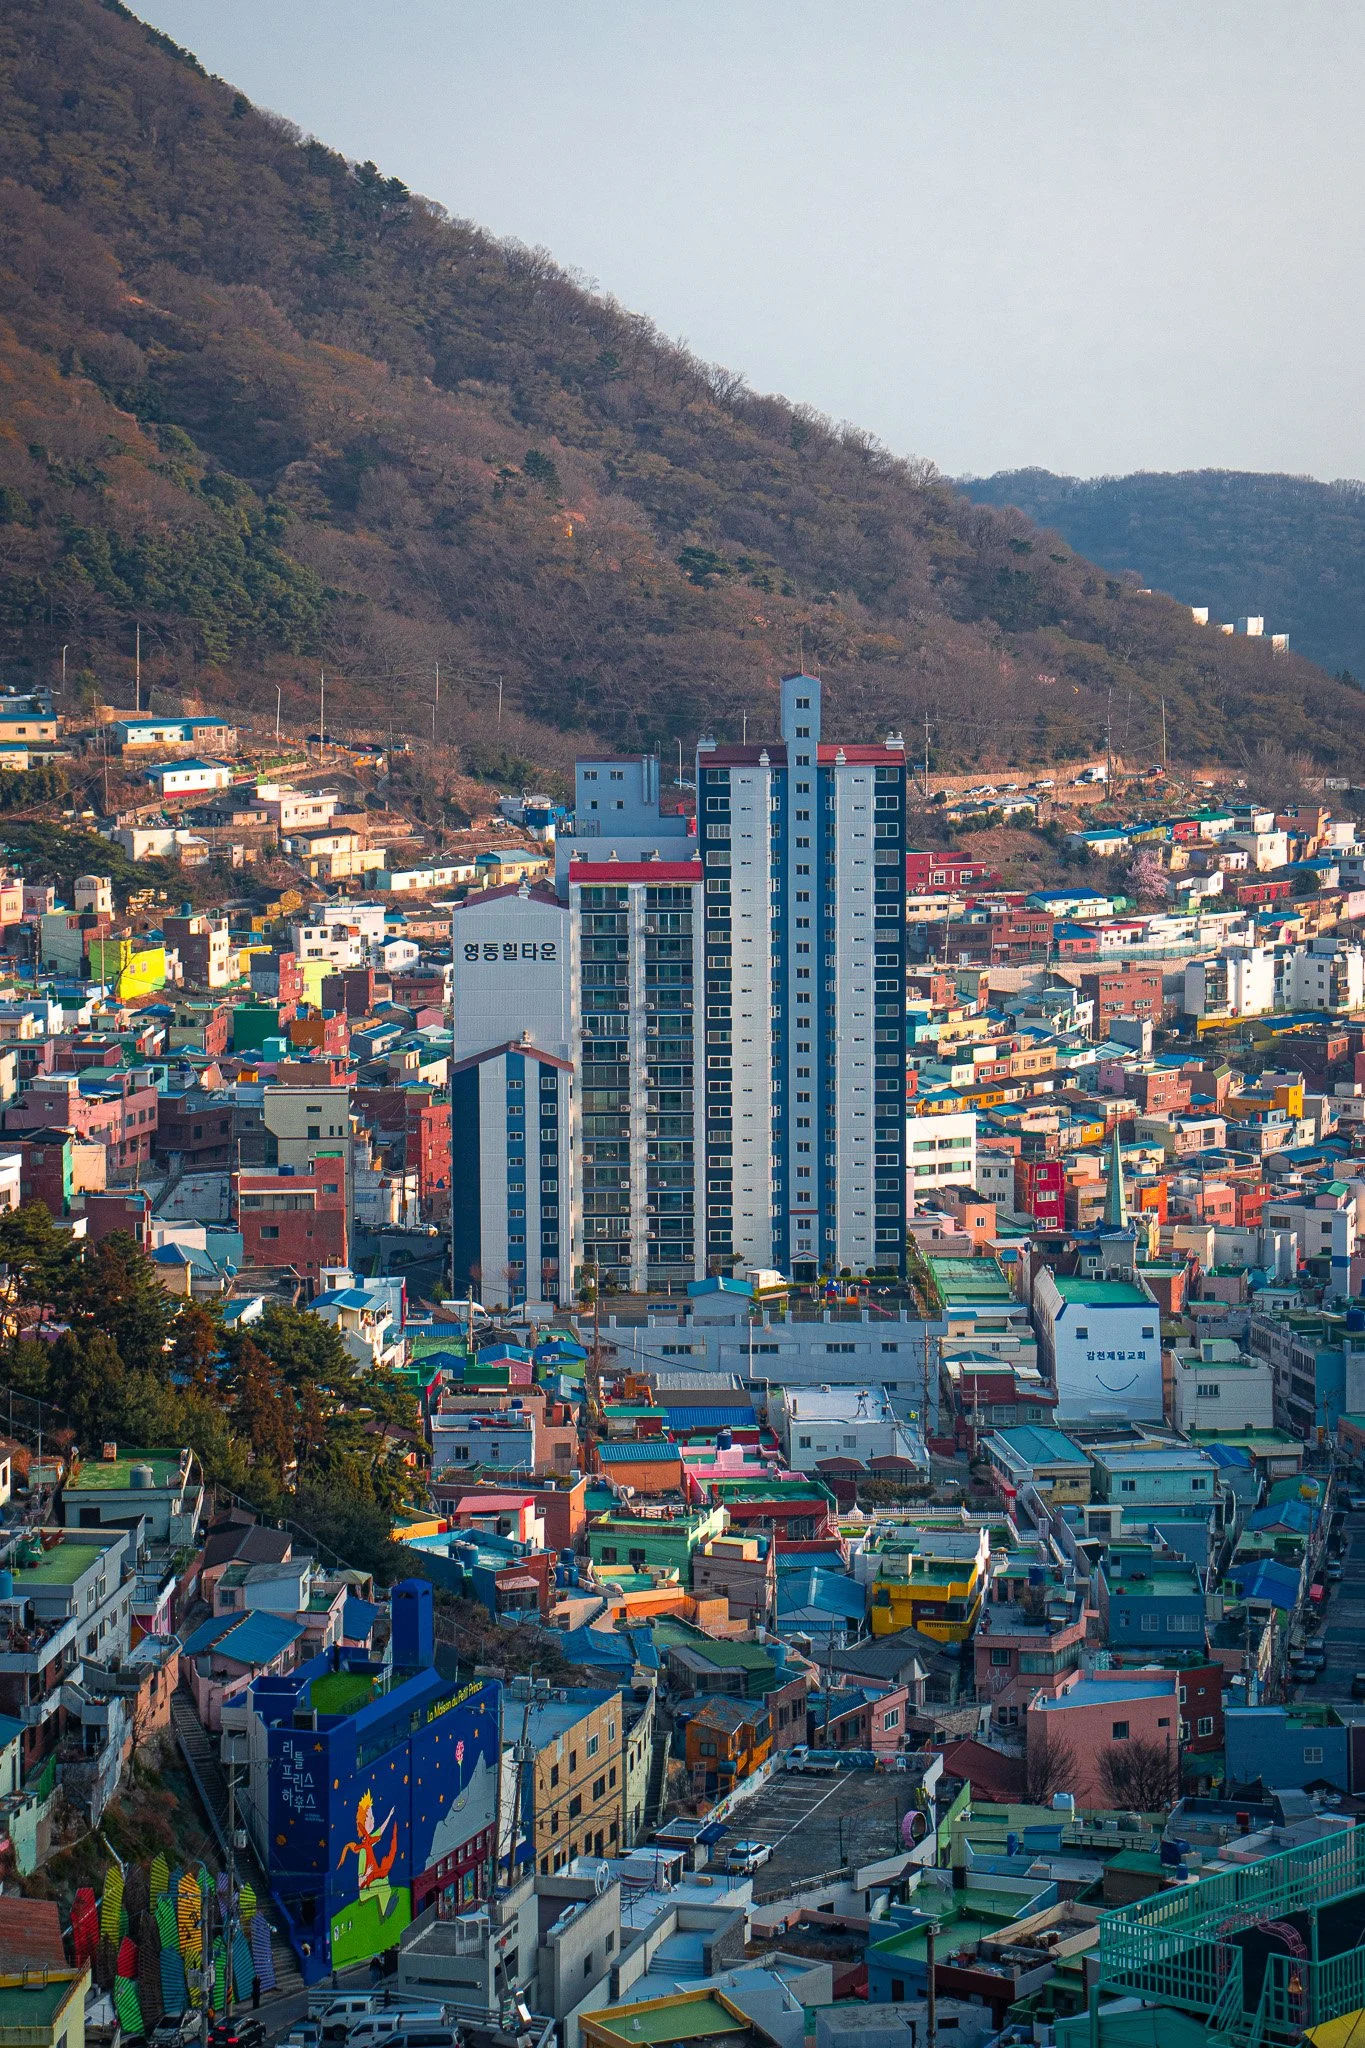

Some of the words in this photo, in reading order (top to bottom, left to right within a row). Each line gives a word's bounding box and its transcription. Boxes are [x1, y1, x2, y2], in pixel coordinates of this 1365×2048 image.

[464, 943, 556, 961] 영동힐타운
[1086, 1351, 1146, 1360] 감천제일교회
[469, 1681, 483, 1696] Prince
[282, 1740, 304, 1770] 리틀
[282, 1764, 314, 1792] 프린스
[282, 1788, 316, 1813] 하우스
